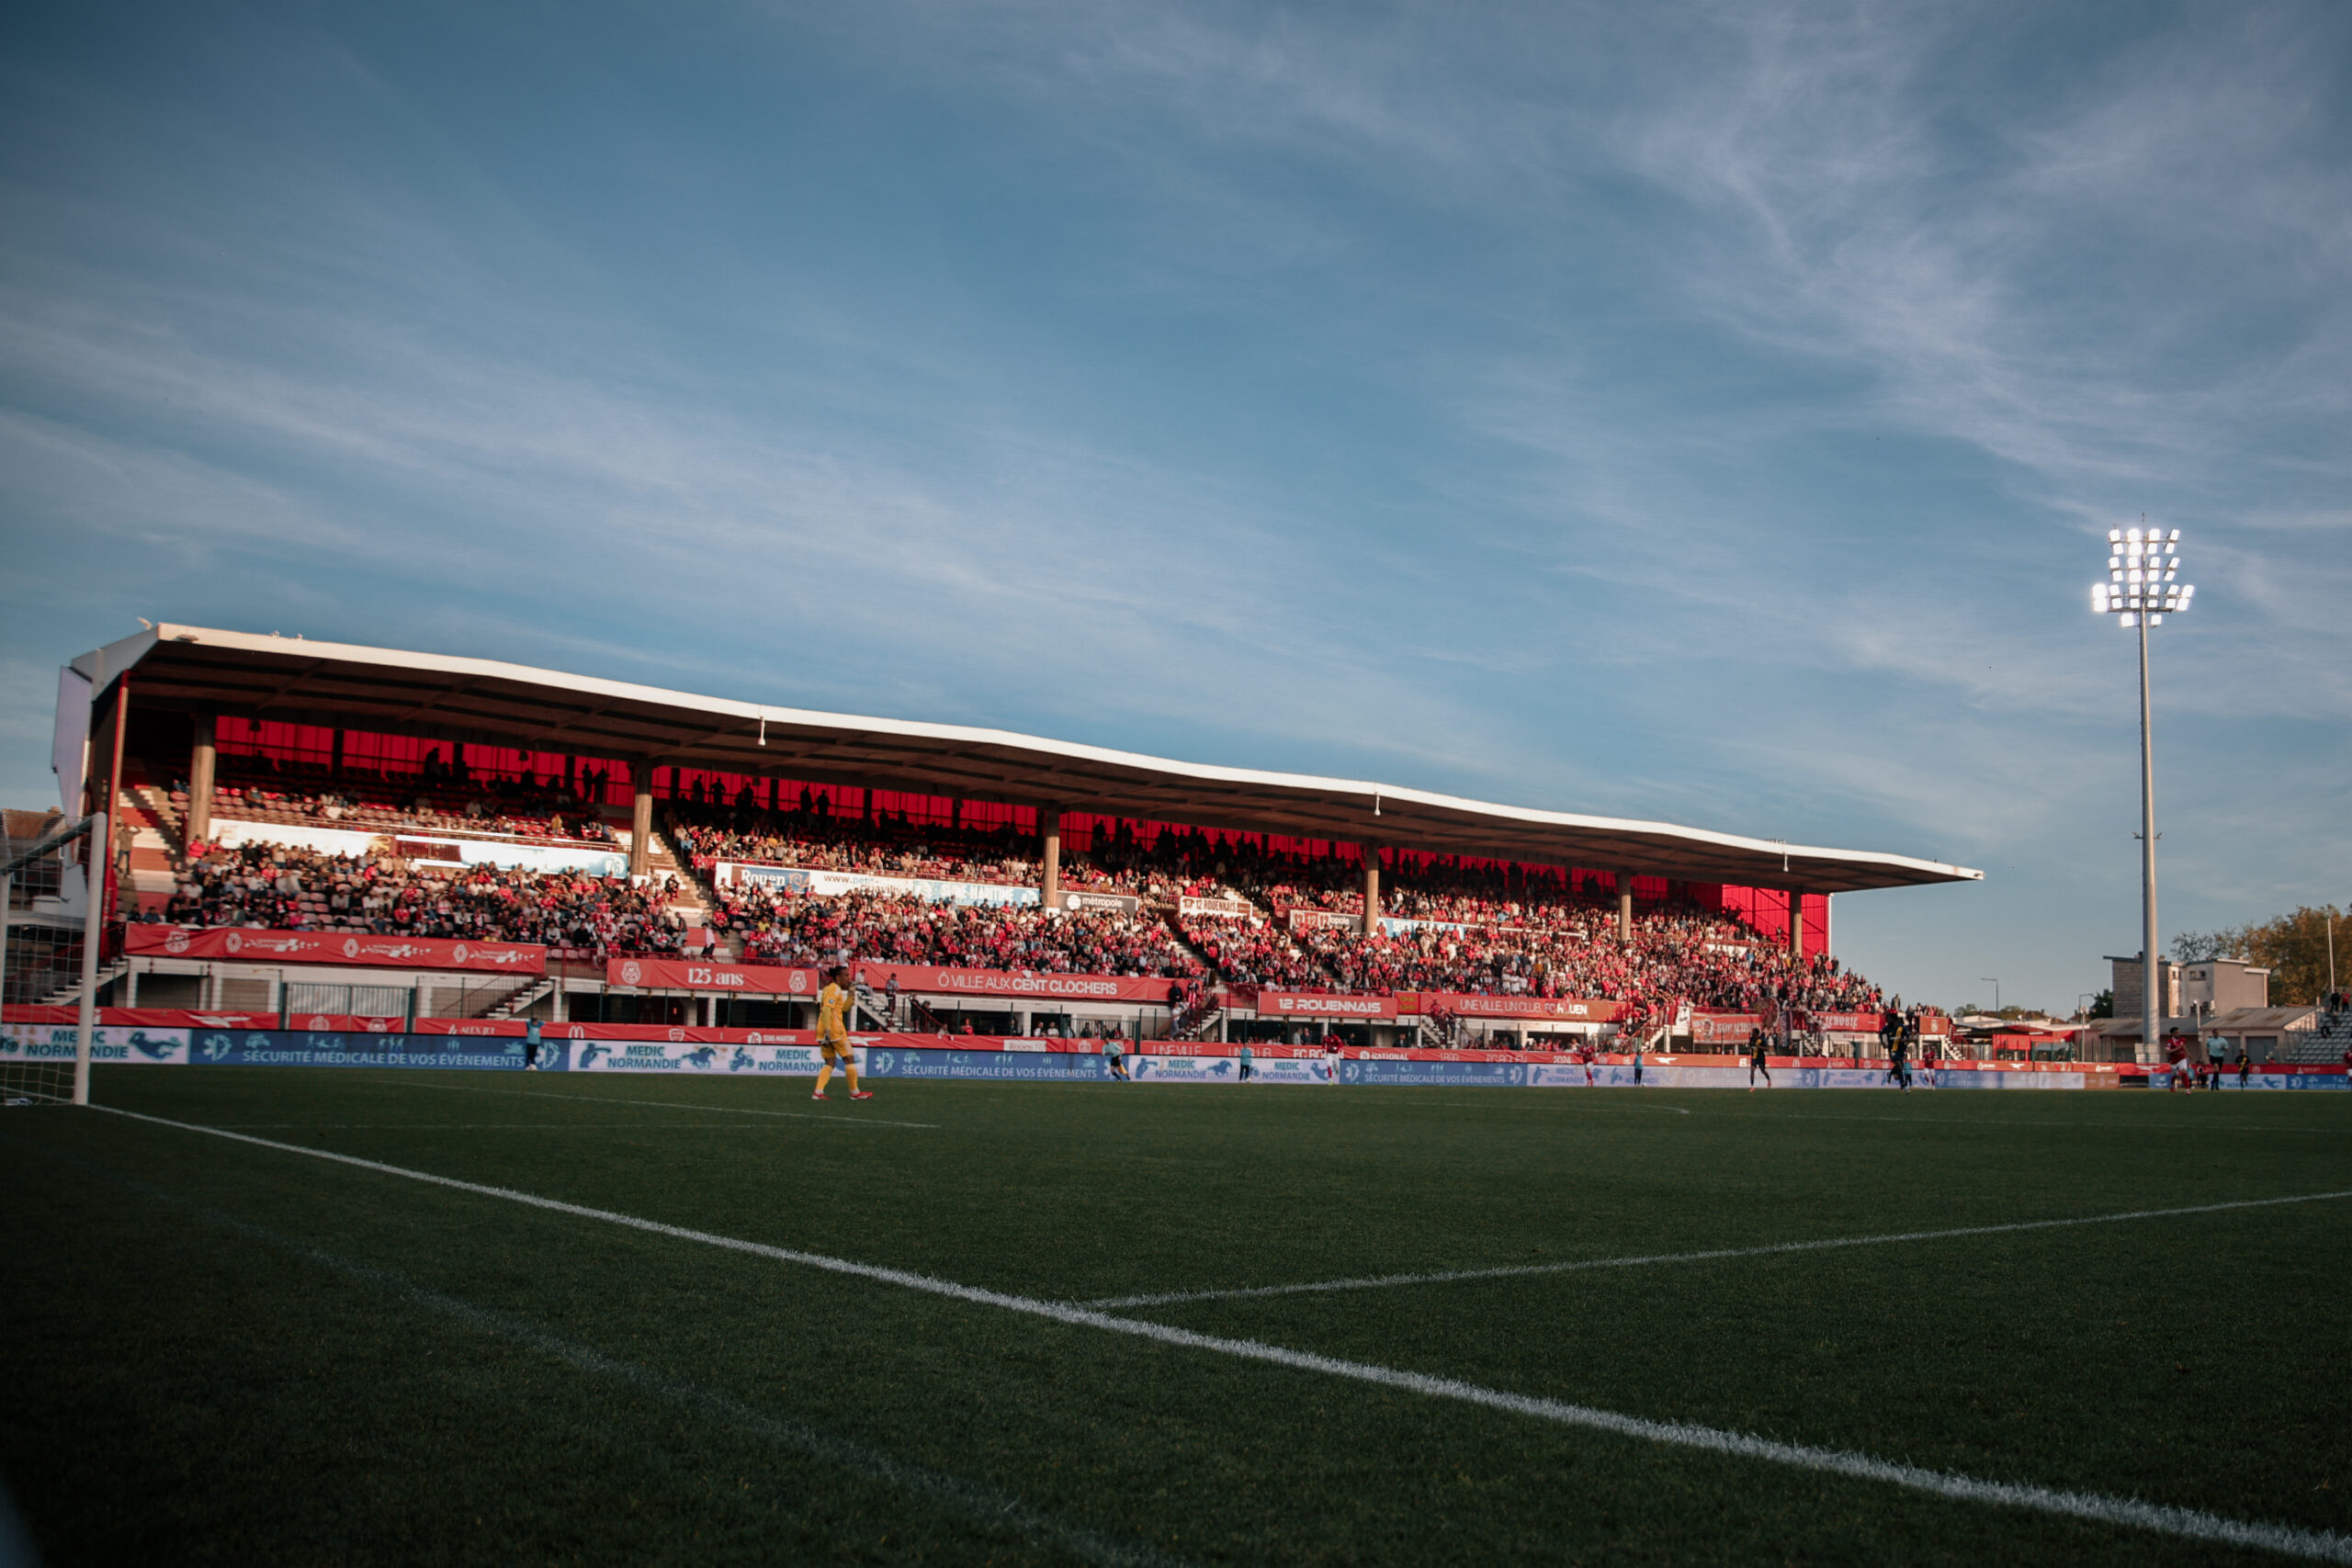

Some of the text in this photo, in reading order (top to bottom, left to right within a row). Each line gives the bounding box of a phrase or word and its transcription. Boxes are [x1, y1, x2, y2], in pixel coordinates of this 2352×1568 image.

[741, 870, 786, 886] Rouen
[1082, 896, 1123, 908] métropole
[688, 967, 744, 987] 125 ans
[951, 976, 984, 989] VILLE
[985, 976, 1012, 989] AUX
[1012, 978, 1047, 992] CENT
[1049, 979, 1118, 996] CLOCHERS
[1279, 998, 1382, 1013] 12 ROUENNAIS
[1459, 998, 1479, 1010] UNE
[1505, 1001, 1518, 1012] UN
[1544, 1004, 1556, 1014] FC
[52, 1031, 107, 1043] MEIC
[26, 1044, 130, 1058] NORMNDIE
[626, 1045, 664, 1056] MEDIC
[776, 1049, 811, 1060] MEDIC
[243, 1049, 311, 1063] SÉCURITÉ
[314, 1050, 386, 1064] MÉDICALE
[388, 1054, 406, 1064] DE
[409, 1054, 437, 1066] VOS
[607, 1058, 683, 1069] NORMANDIE
[1168, 1059, 1196, 1068] MEDIC
[902, 1063, 948, 1076] SÉCURITÉ
[950, 1064, 1000, 1077] MÉDICALE
[1001, 1066, 1015, 1077] DE
[1016, 1066, 1035, 1077] VOS
[1273, 1061, 1300, 1071] MEDIC
[1156, 1070, 1207, 1080] NORMANDIE
[1262, 1072, 1310, 1081] NORMANDIE
